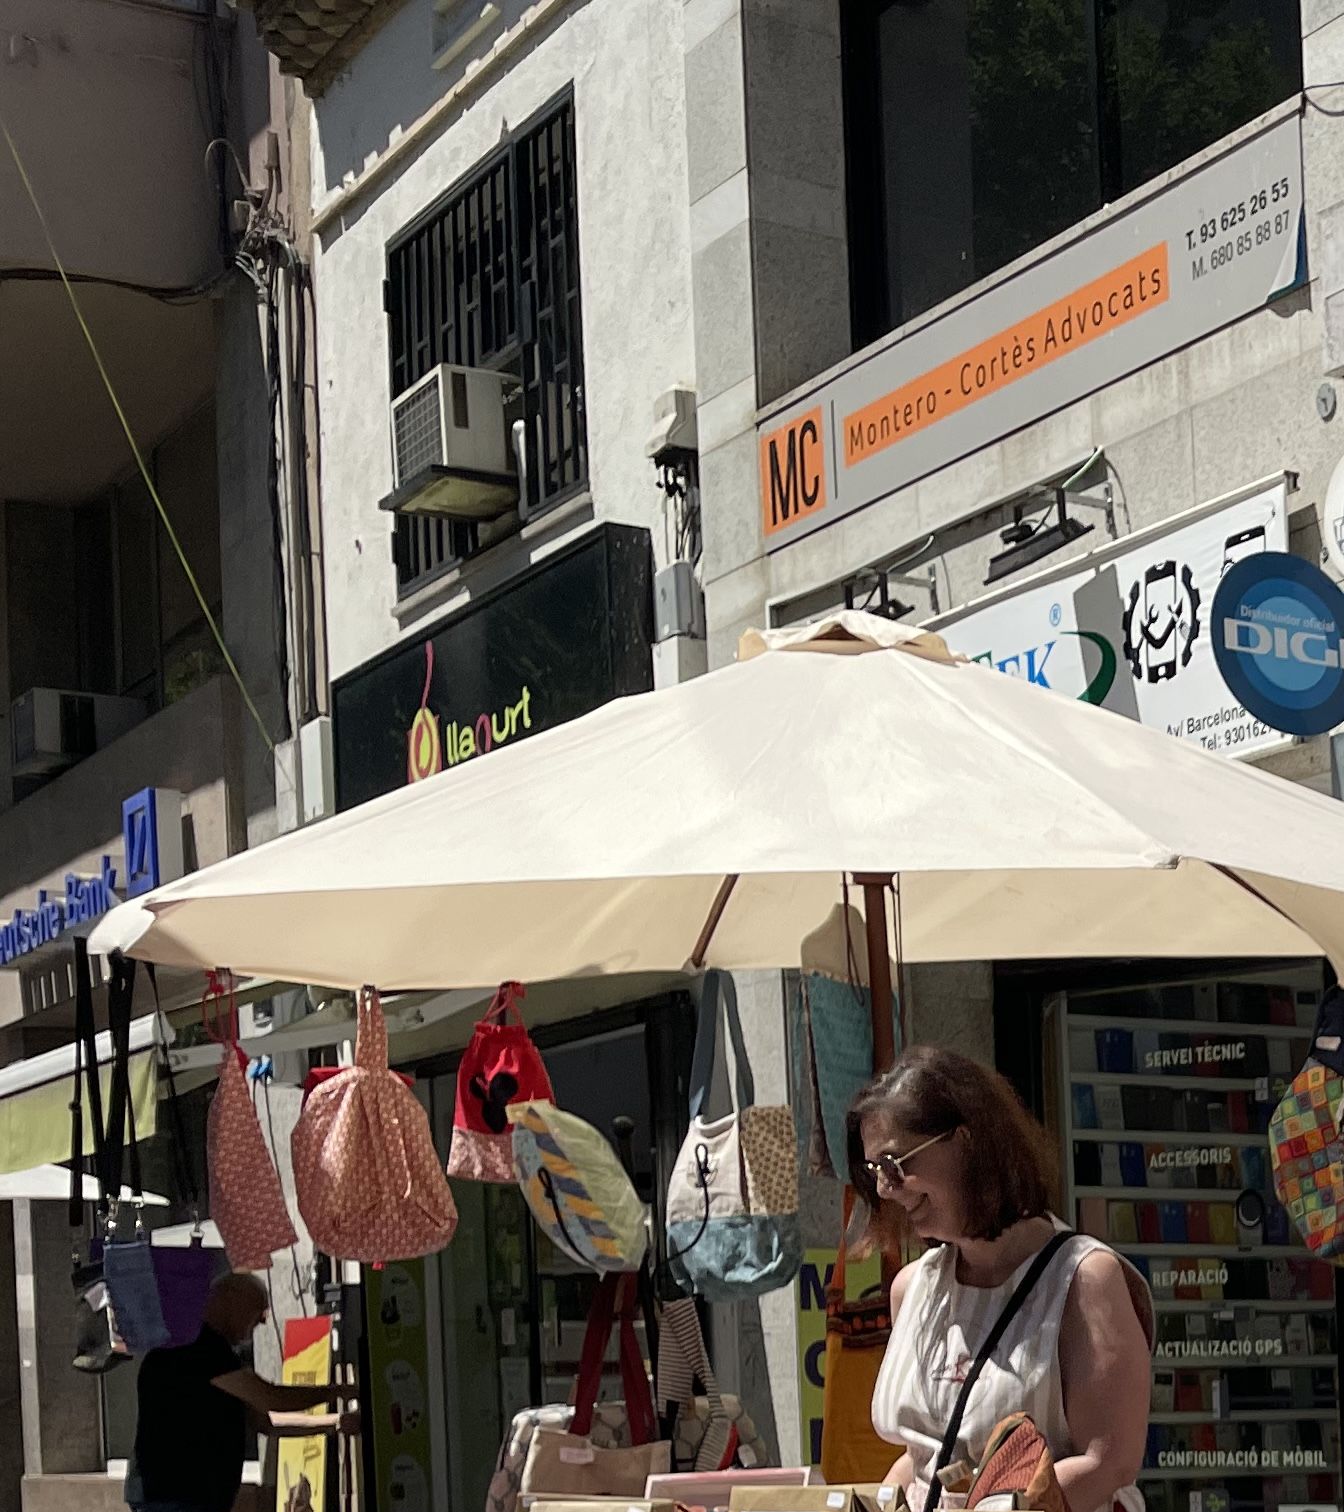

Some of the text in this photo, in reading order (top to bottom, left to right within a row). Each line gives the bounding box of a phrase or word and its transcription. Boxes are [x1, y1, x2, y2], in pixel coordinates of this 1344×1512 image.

[1186, 177, 1289, 251] T. 93 625 26 55
[1192, 209, 1290, 281] M. 680 85 88 87
[850, 390, 937, 456] Montero
[959, 336, 1036, 397] Cortès
[1043, 267, 1162, 353] Advocats
[768, 419, 820, 526] MC
[1187, 705, 1247, 735] Barcelona
[1200, 720, 1273, 752] Tel: 930162
[65, 855, 122, 928] Bank
[1145, 1045, 1193, 1068] SERVEI
[1149, 1147, 1232, 1169] ACCESSORIS
[1152, 1266, 1229, 1287] REPARACIÓ
[1155, 1335, 1283, 1358] ACTUALIZACIÓ GPS
[1157, 1445, 1327, 1468] CONFIGURACIÓ DE MÒBIL
